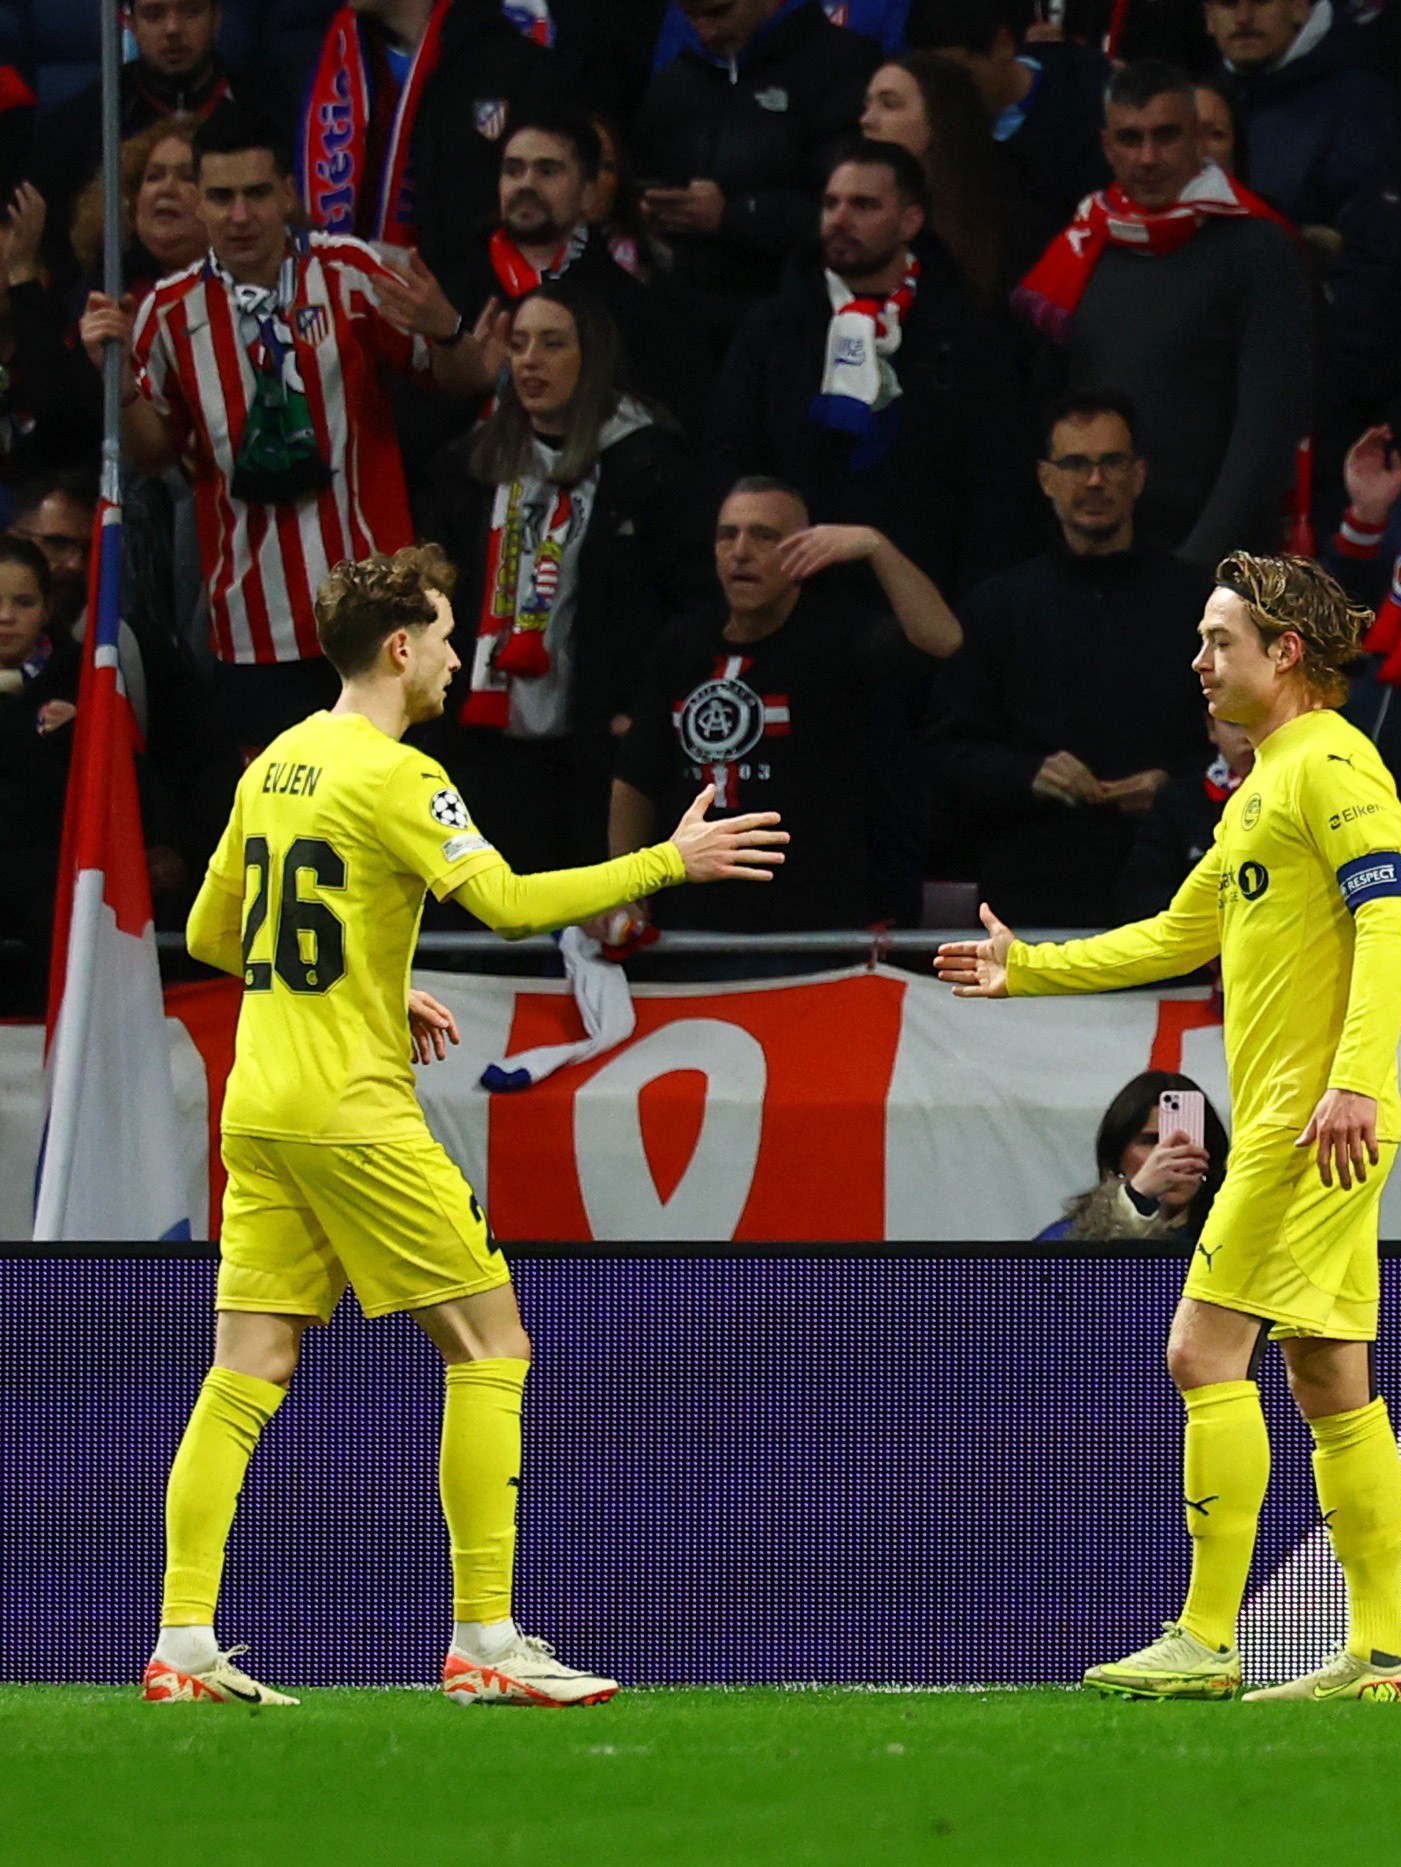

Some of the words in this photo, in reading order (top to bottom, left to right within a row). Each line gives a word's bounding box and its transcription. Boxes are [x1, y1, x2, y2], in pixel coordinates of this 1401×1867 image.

[262, 762, 323, 797] EVJEN
[1347, 867, 1395, 890] RESPECT
[243, 834, 348, 996] 26
